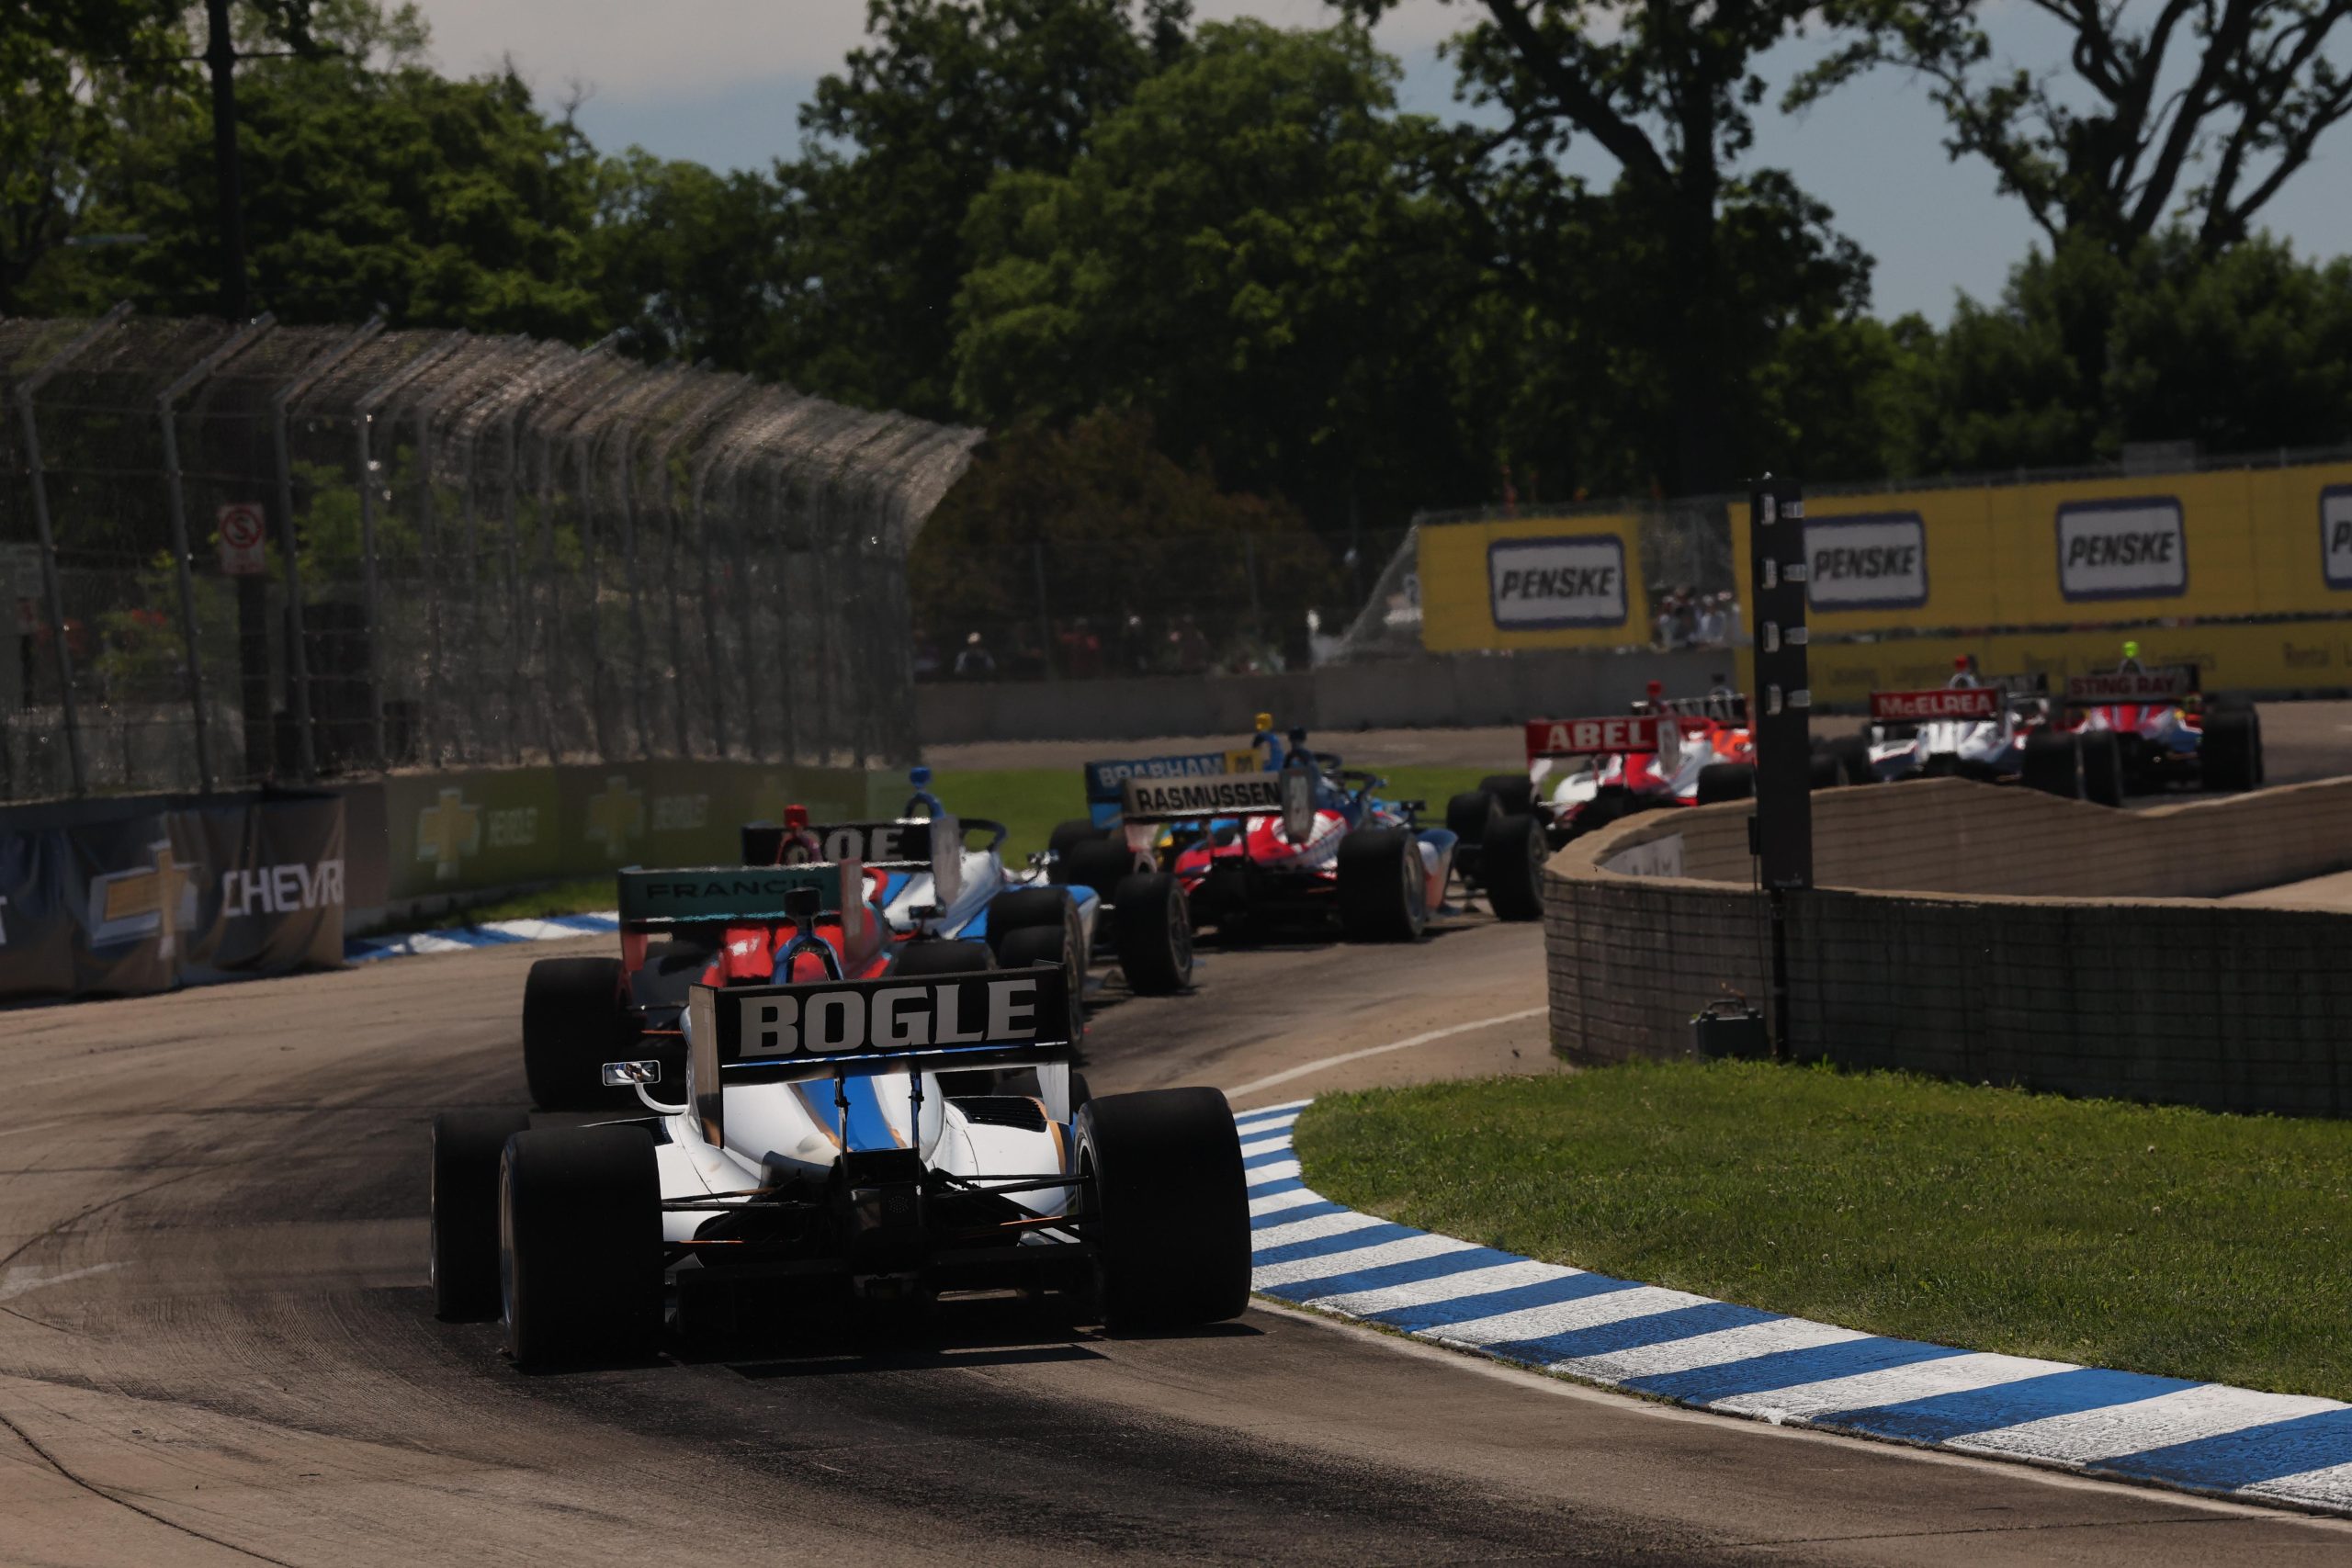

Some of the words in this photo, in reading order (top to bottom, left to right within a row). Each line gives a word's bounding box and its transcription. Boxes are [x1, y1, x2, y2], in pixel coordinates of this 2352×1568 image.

[1815, 545, 1915, 581] PENSKE
[2068, 531, 2175, 567] PENSKE
[1500, 567, 1615, 600] PENSKE
[2070, 676, 2132, 695] STING
[2138, 675, 2177, 692] RAY
[1877, 694, 1992, 716] McELREA
[1546, 721, 1651, 750] ABEL
[1136, 781, 1283, 812] RASMUSSEN
[647, 876, 823, 898] FRANCIS
[739, 978, 1036, 1057] BOGLE
